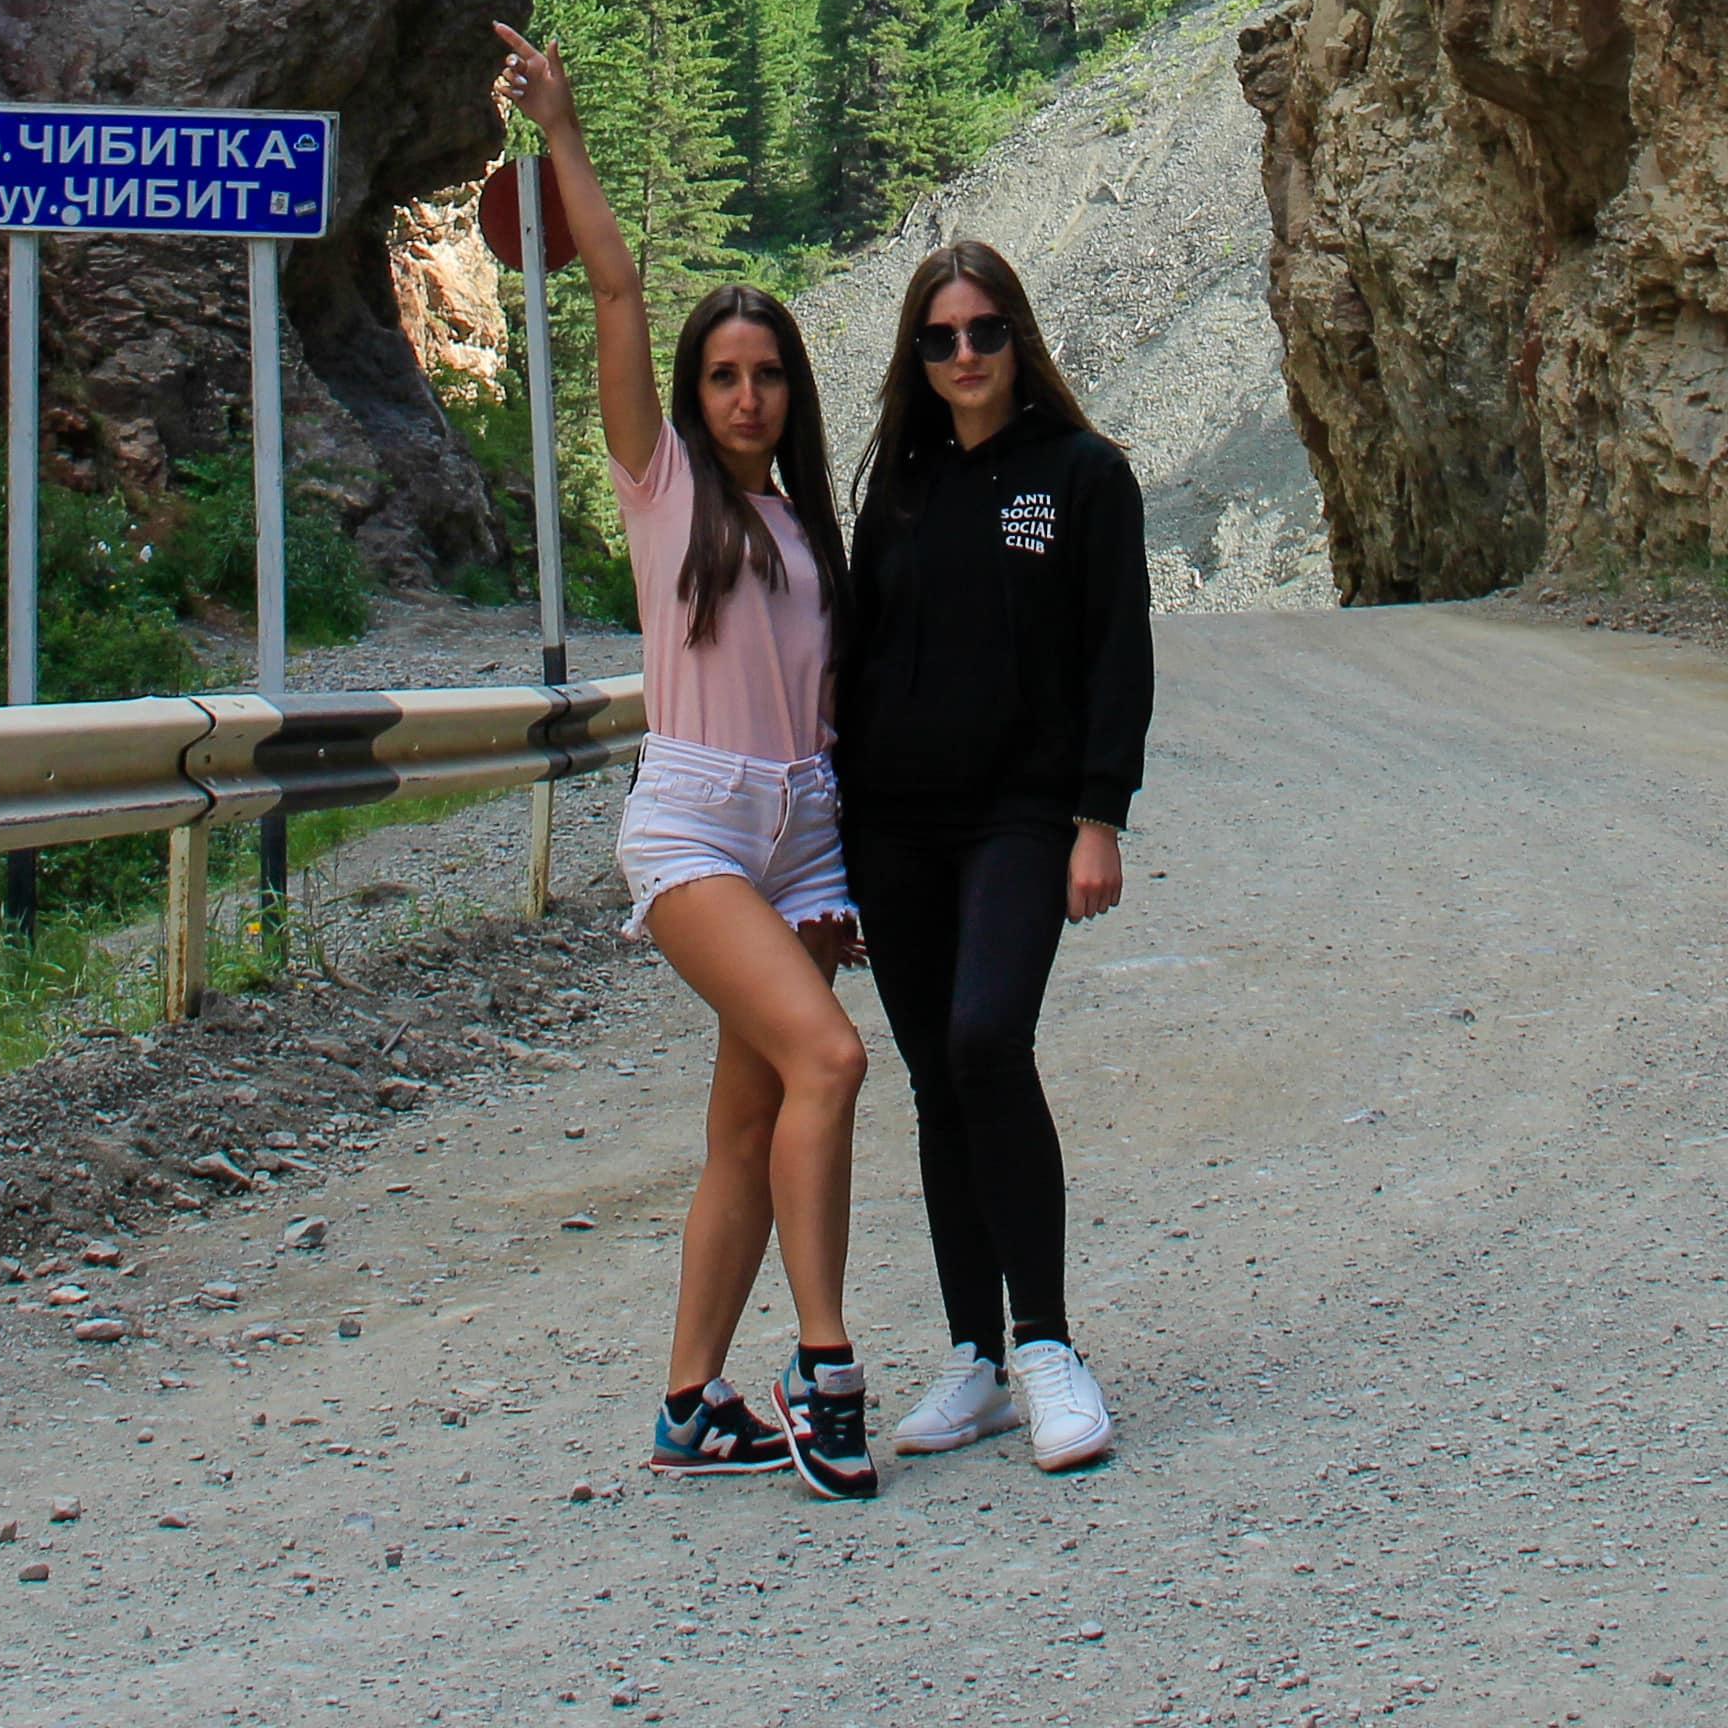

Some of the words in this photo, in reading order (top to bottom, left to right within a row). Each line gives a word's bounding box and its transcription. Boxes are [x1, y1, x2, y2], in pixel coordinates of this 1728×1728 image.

[19, 124, 296, 169] ЧИБИТКА
[64, 176, 260, 220] ЧИБИТ
[1012, 493, 1051, 506] ANTI
[1000, 506, 1056, 520] SOCIAL
[1005, 535, 1045, 554] CLUB
